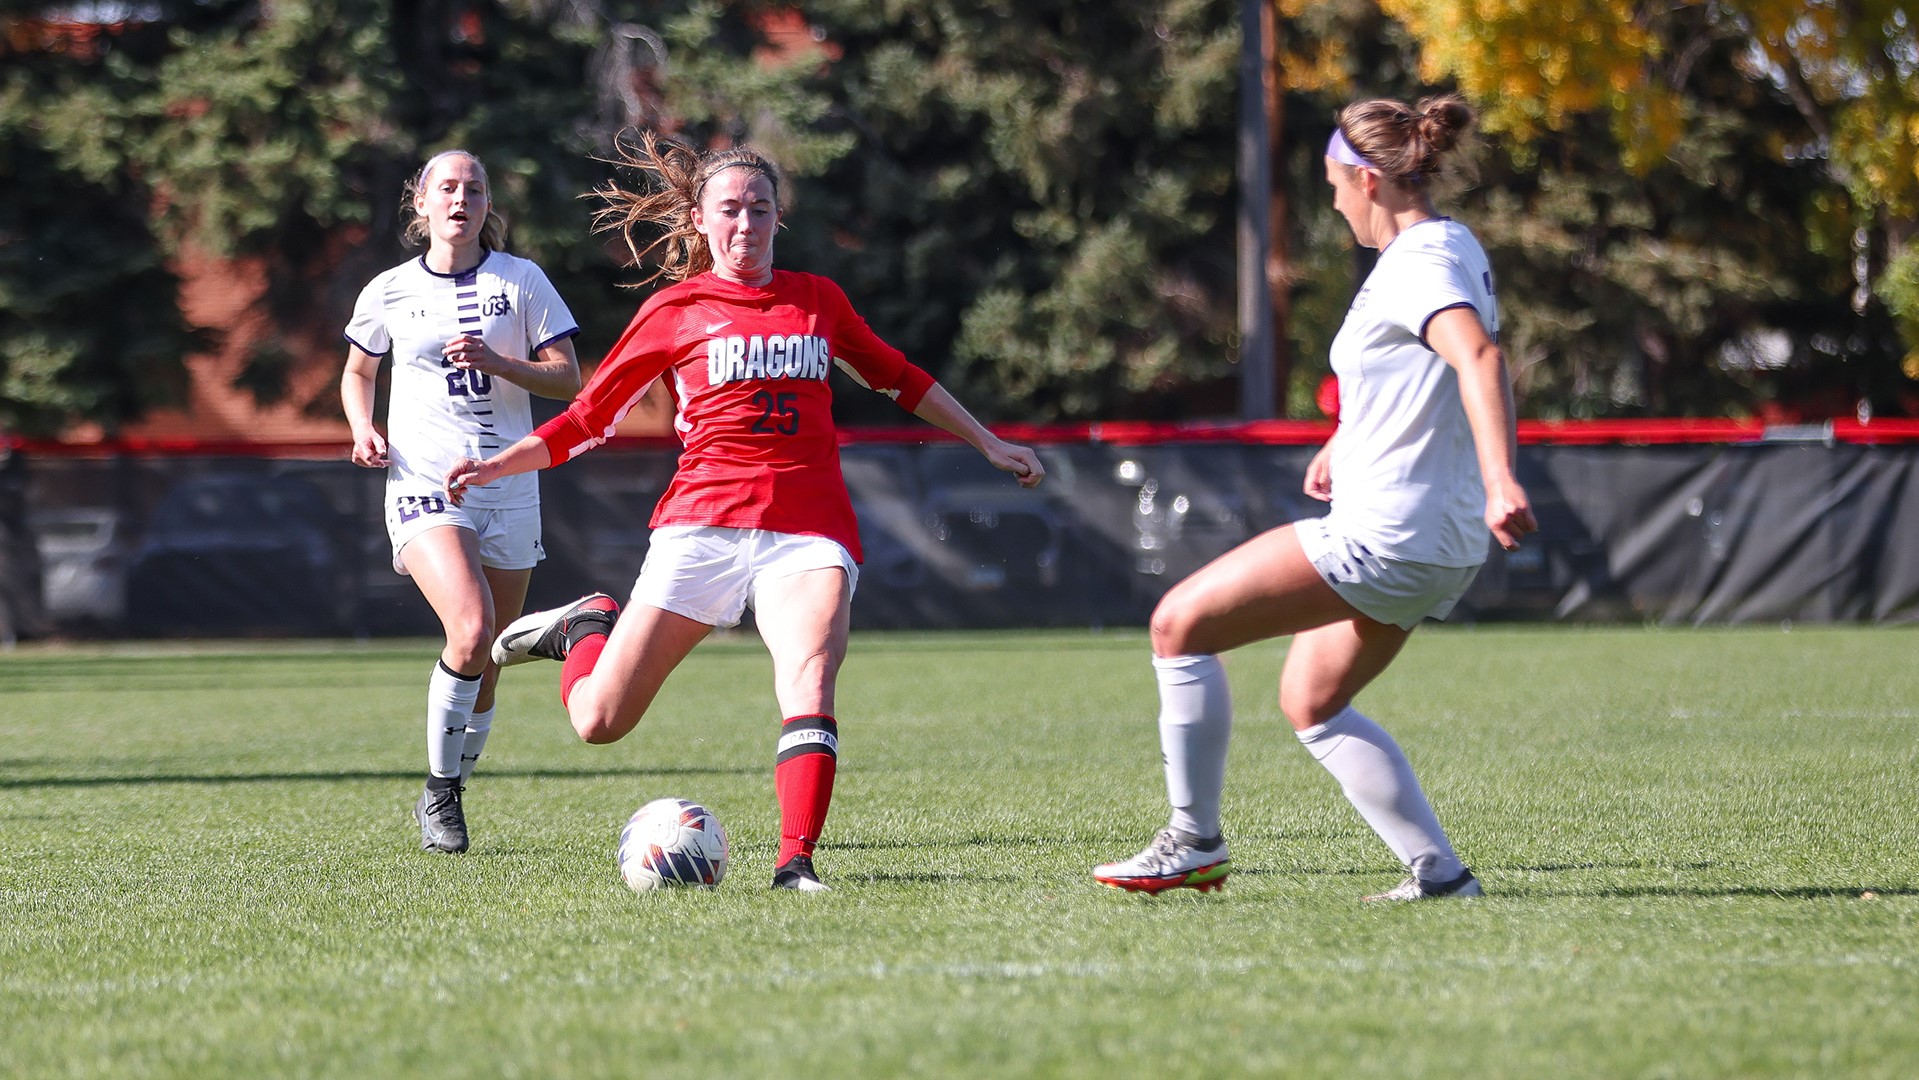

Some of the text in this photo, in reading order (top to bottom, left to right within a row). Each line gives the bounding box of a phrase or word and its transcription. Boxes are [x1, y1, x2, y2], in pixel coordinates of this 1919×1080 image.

[441, 354, 492, 397] 20
[707, 334, 830, 387] DRAGONS
[752, 391, 799, 436] 25
[397, 495, 445, 525] 20
